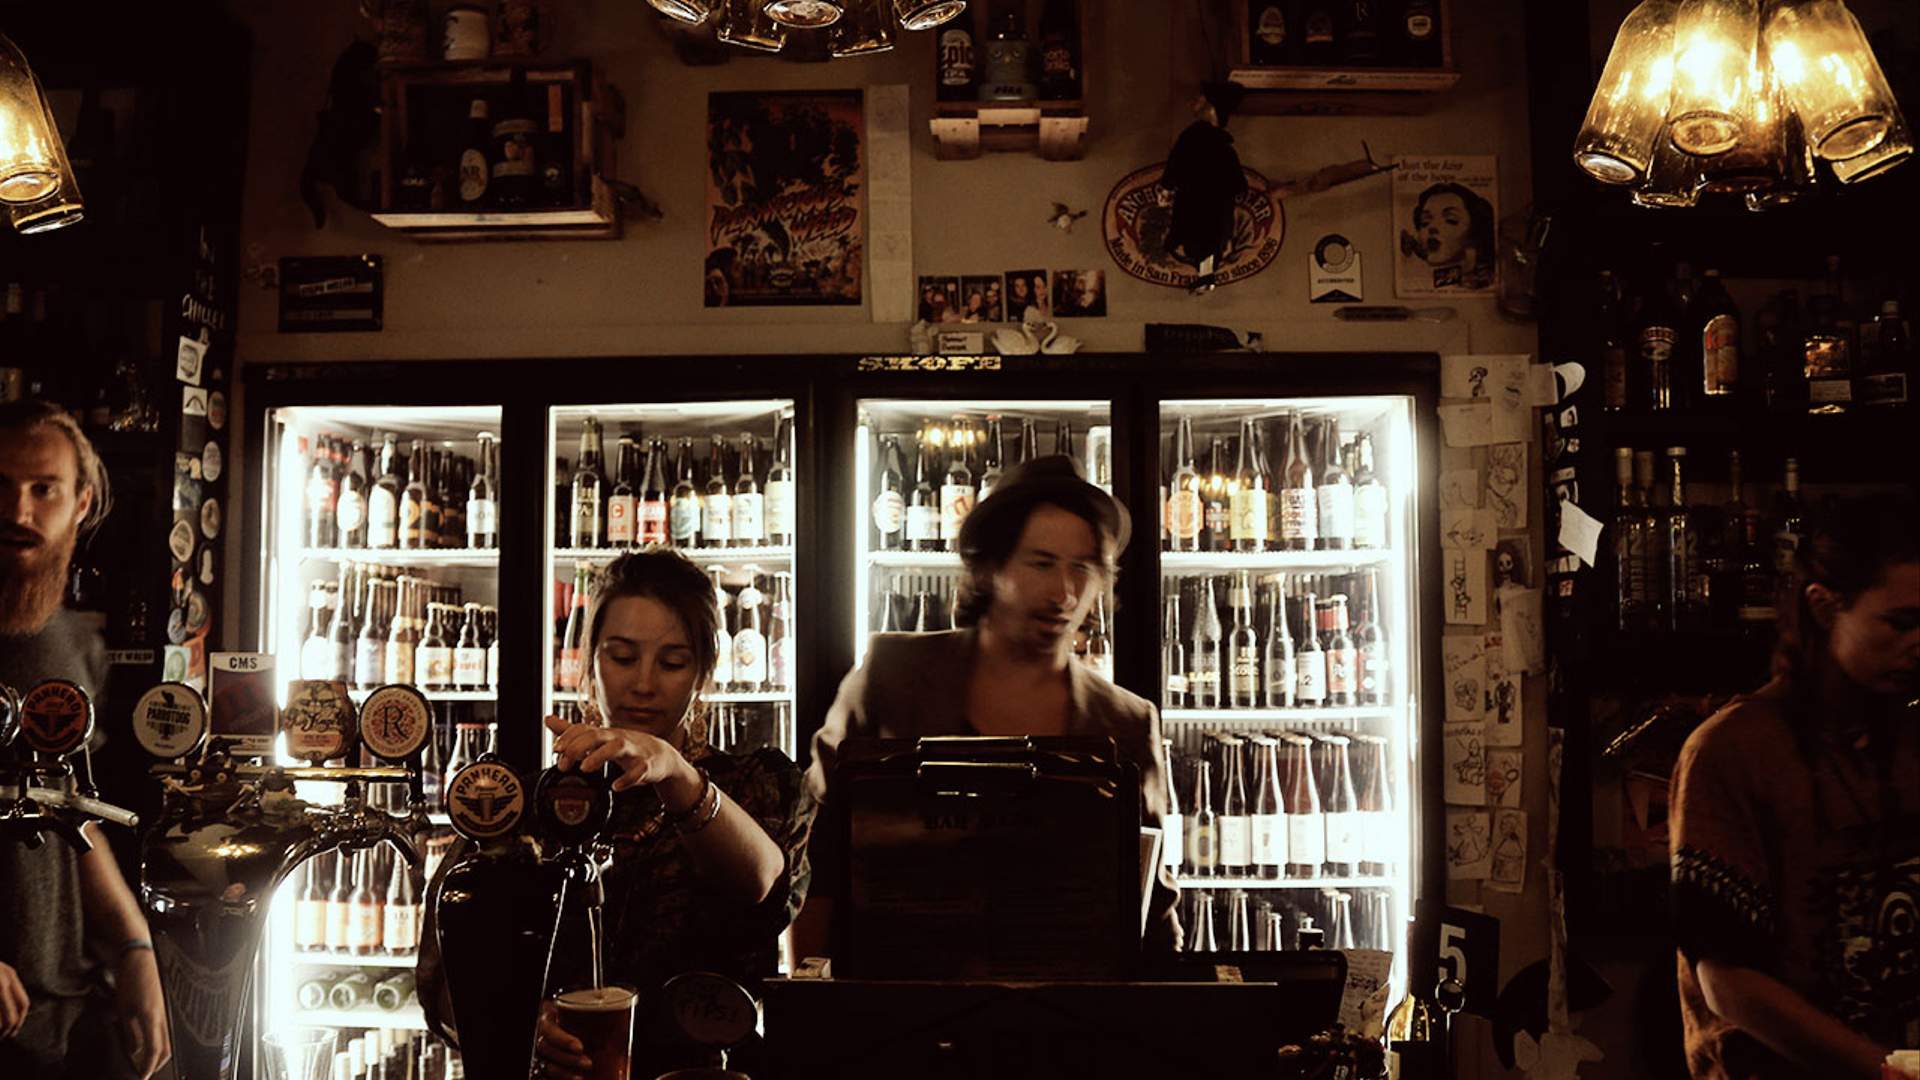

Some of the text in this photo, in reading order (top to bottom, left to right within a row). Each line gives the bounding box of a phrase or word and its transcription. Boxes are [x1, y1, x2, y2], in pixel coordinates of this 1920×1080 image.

[1147, 267, 1169, 282] San
[1170, 271, 1230, 285] Franco
[1231, 260, 1259, 277] since
[229, 656, 258, 669] CMS
[383, 706, 410, 740] R
[455, 766, 518, 796] PANHEAD
[1438, 921, 1469, 995] 5
